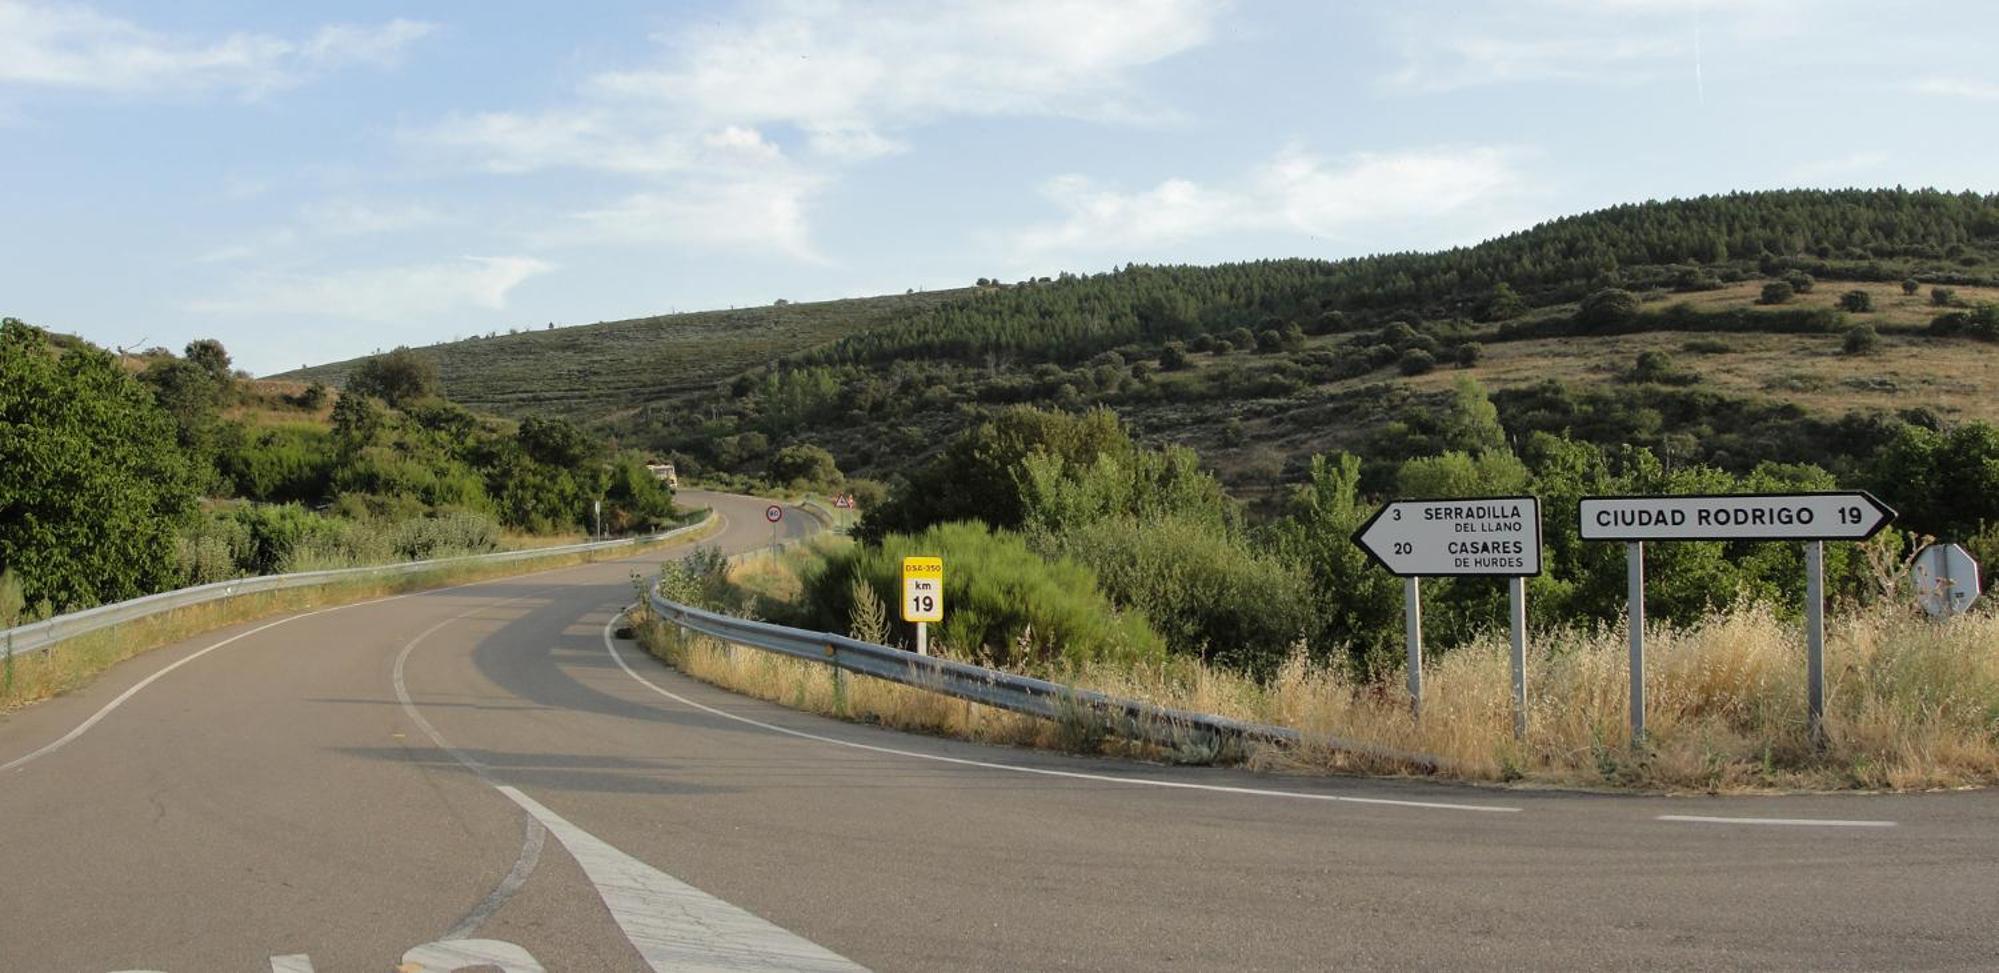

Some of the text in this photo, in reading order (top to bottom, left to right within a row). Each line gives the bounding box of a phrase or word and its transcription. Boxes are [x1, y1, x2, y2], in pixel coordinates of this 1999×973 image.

[1393, 506, 1521, 521] 3 SERRADILLA
[1596, 506, 1863, 527] CIUDAD RODRIGO 19
[1455, 522, 1522, 532] DEL LLANO
[1394, 541, 1523, 555] 20 CASARES
[1454, 557, 1524, 568] DE HURDES
[915, 580, 932, 590] km
[913, 595, 934, 612] 19
